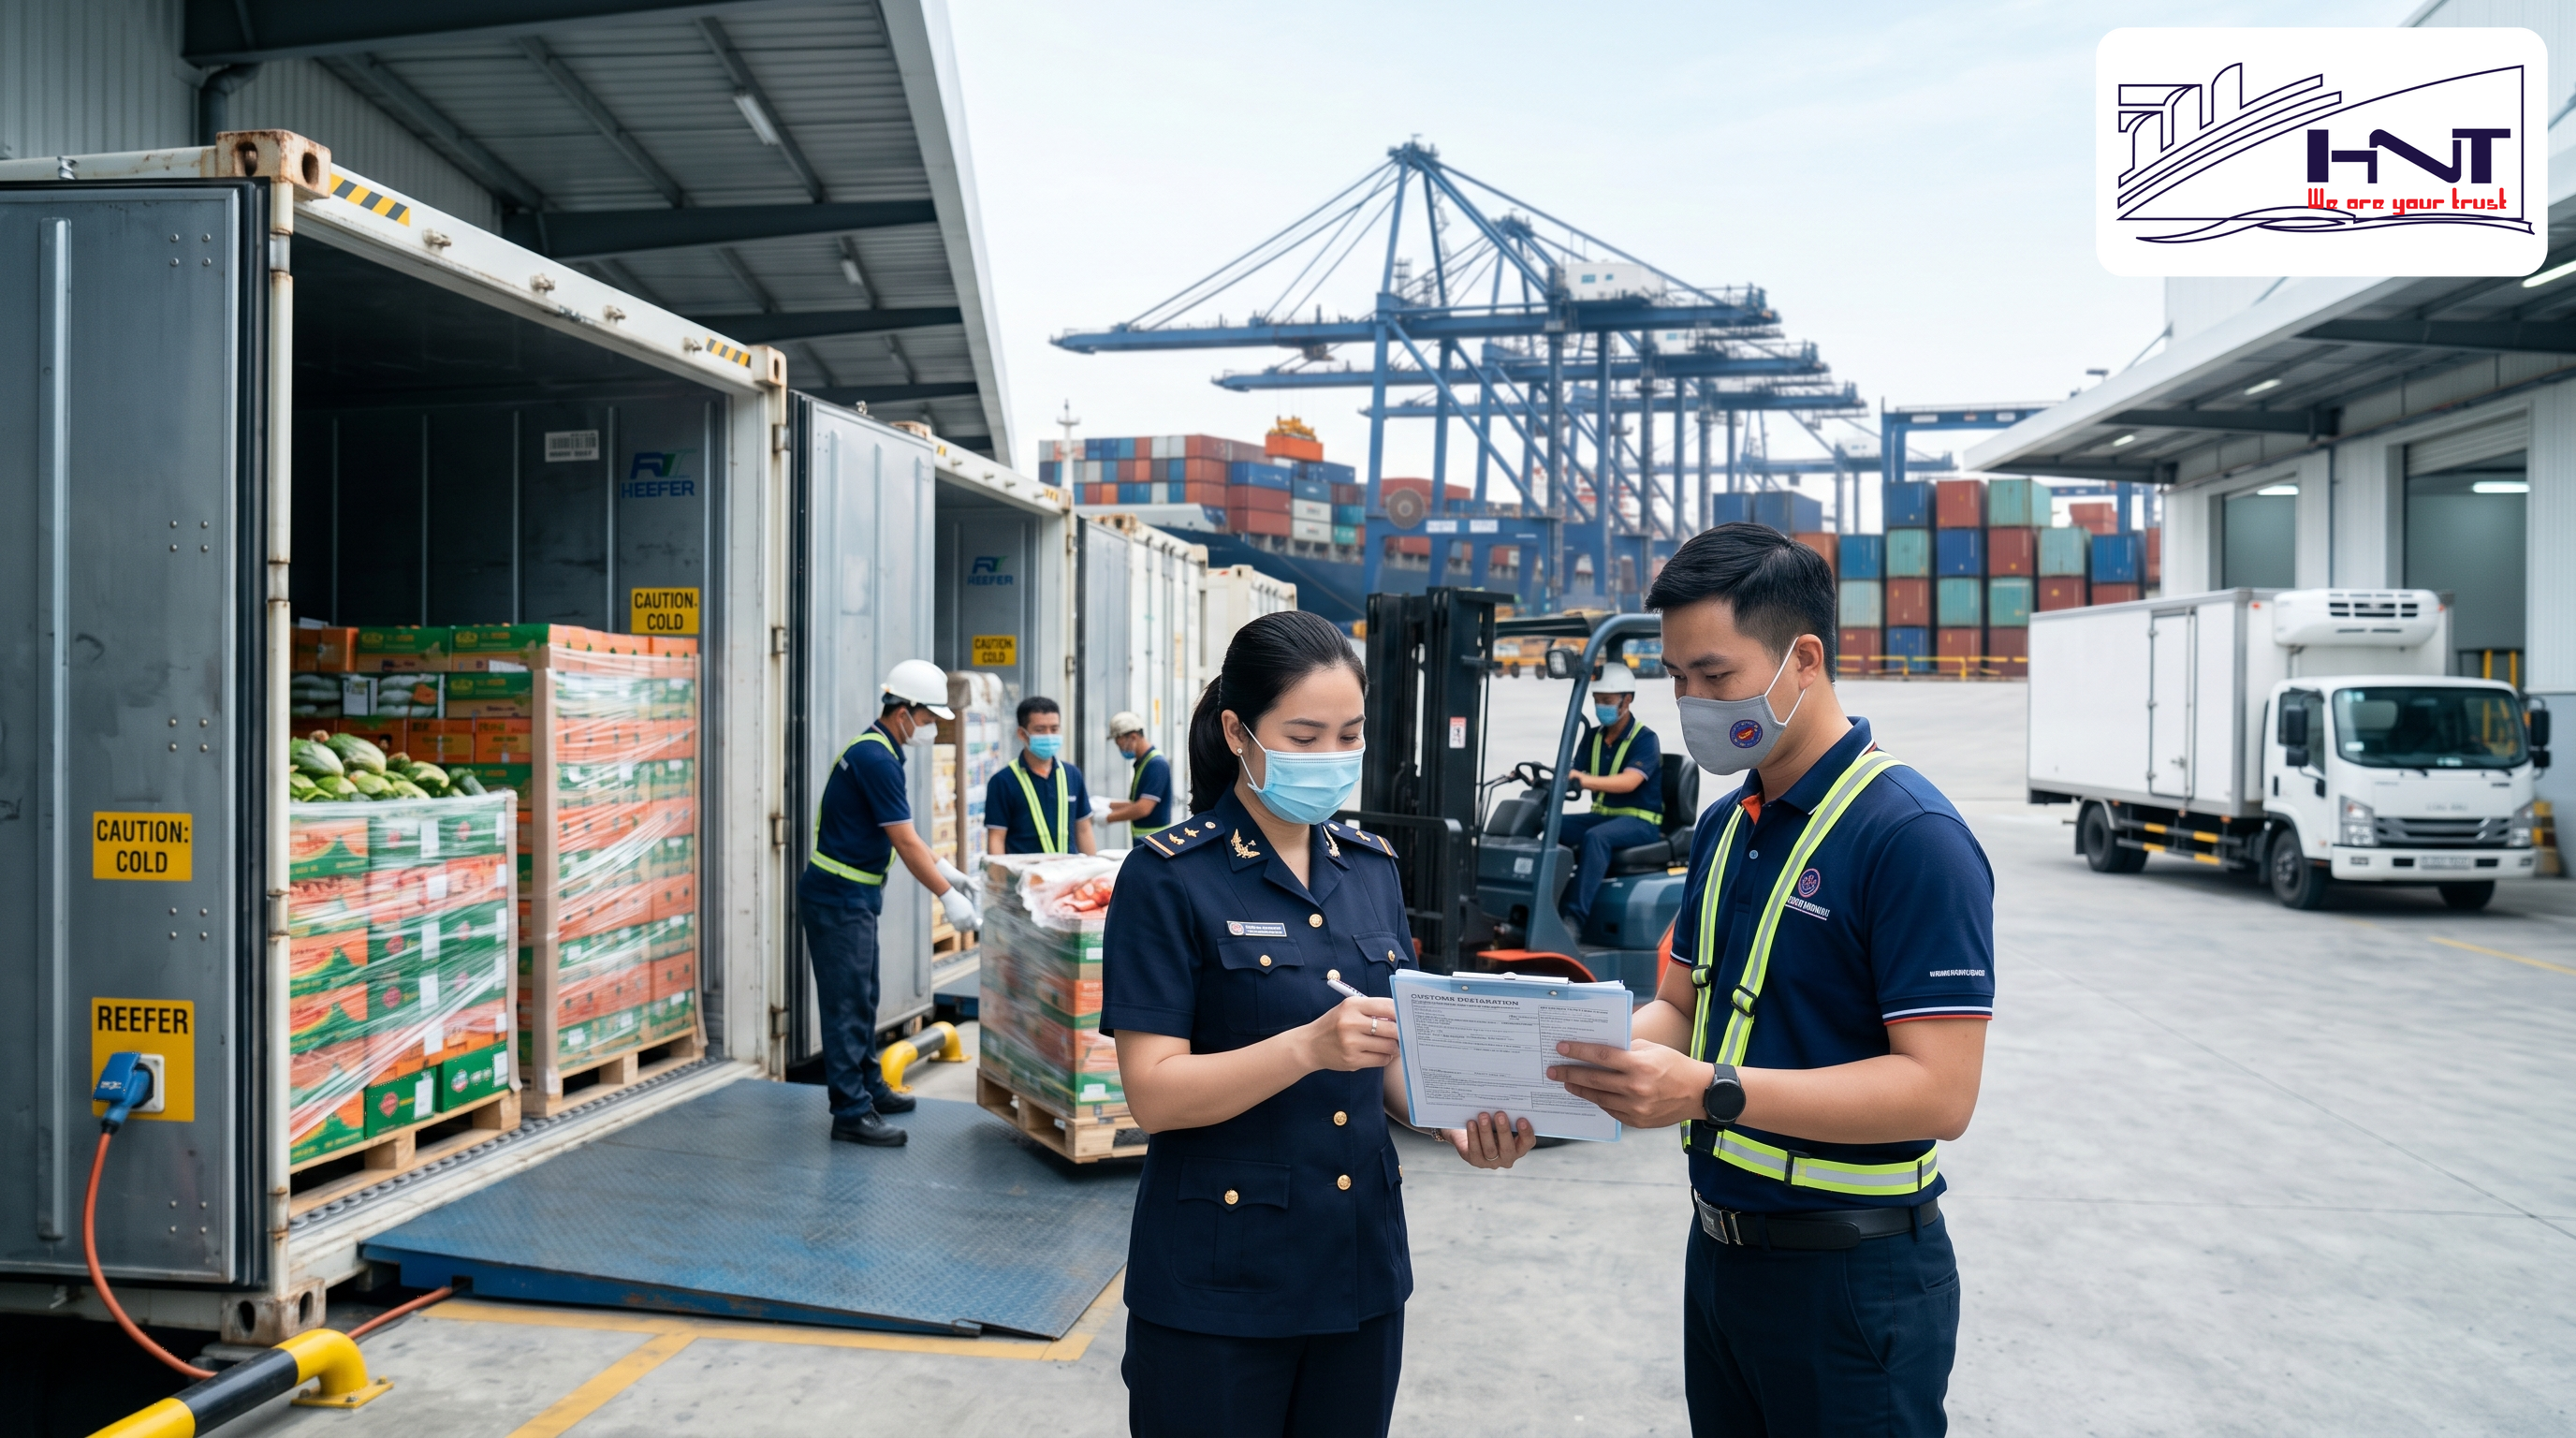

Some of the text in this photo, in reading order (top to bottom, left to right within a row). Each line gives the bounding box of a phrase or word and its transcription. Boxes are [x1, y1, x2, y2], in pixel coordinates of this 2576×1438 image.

[647, 613, 683, 630] COLD
[96, 819, 189, 844] CAUTION:
[116, 850, 168, 873] COLD
[97, 1005, 189, 1034] REEFER
